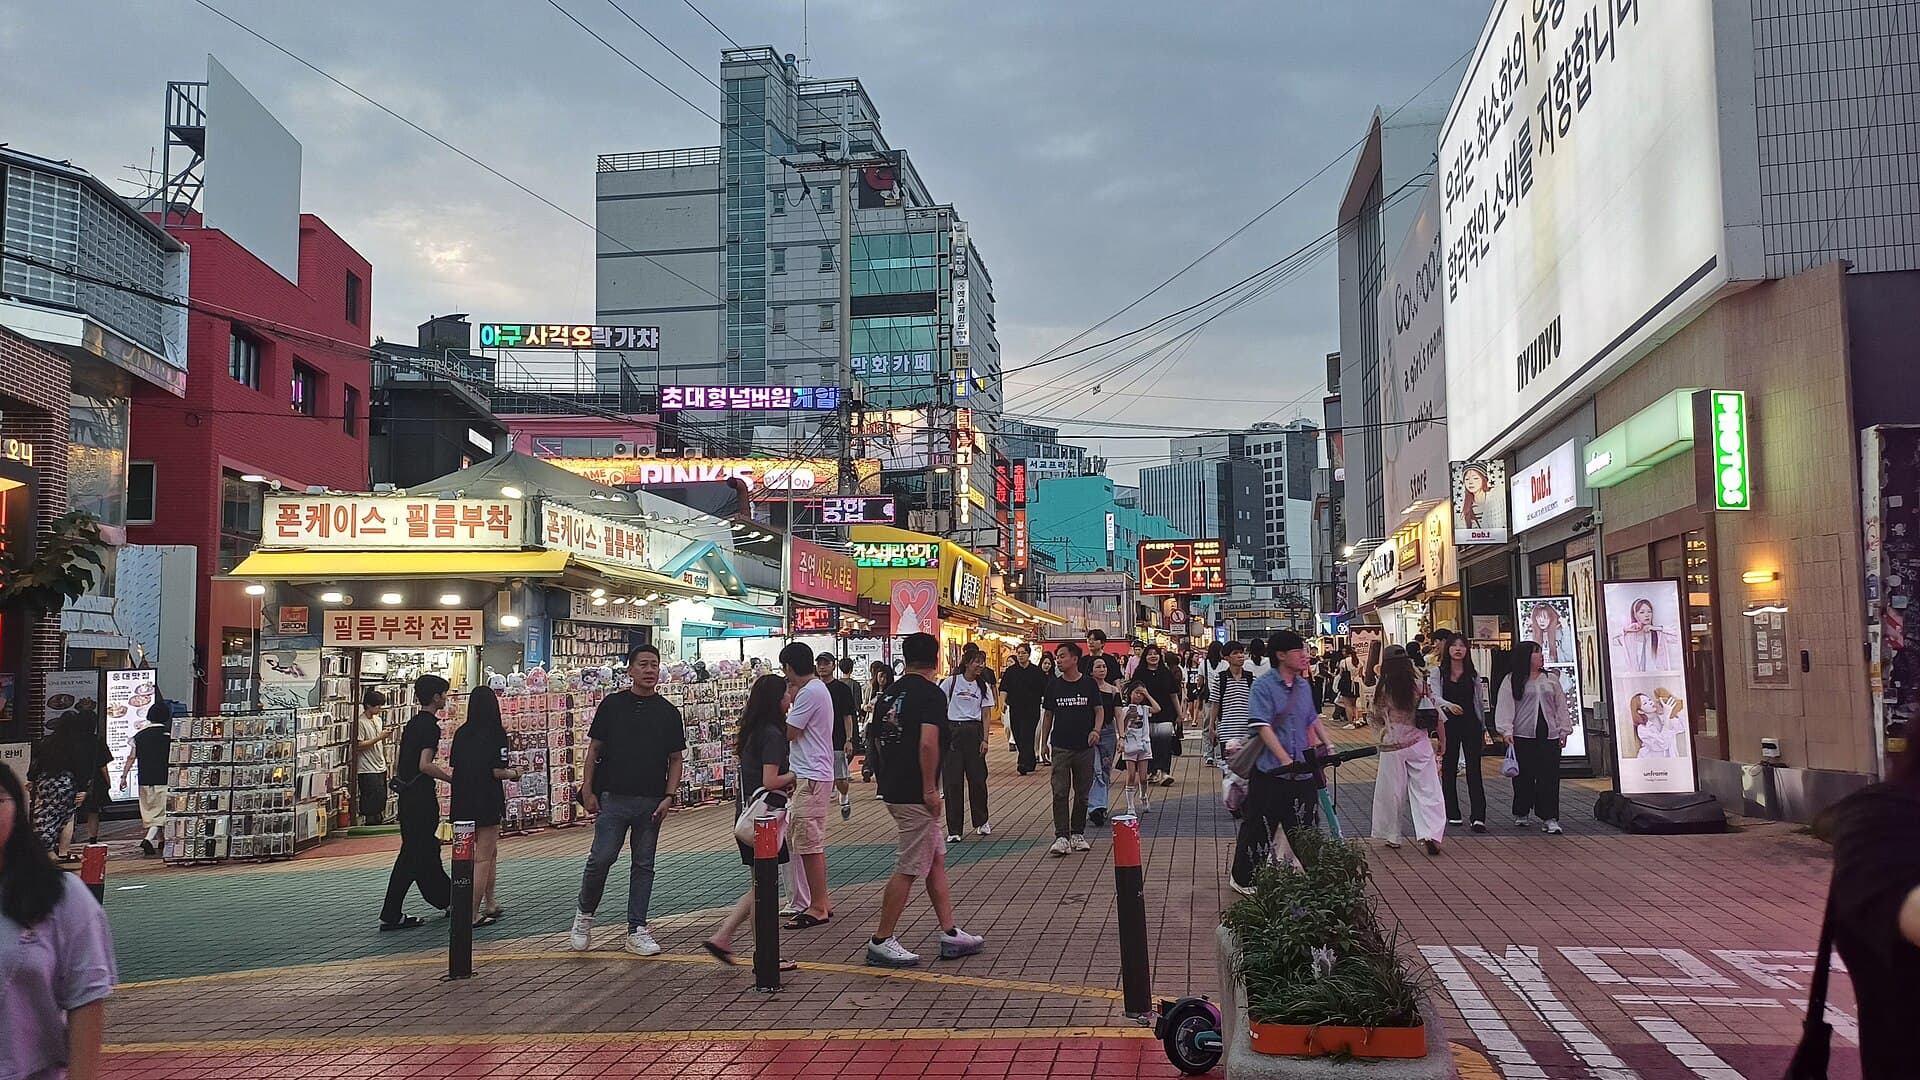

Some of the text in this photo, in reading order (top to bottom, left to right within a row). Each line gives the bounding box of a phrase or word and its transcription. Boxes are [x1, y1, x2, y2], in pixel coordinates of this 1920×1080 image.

[1445, 139, 1475, 224] 우리는
[1477, 14, 1528, 162] 최소한의
[1448, 189, 1490, 304] 합리적인
[1493, 116, 1534, 234] 소비를
[850, 352, 931, 375] 만화카페
[1717, 395, 1744, 505] PHOTOS
[1409, 467, 1428, 500] store
[275, 502, 513, 540] 폰케이스 필름부착
[547, 510, 645, 563] 폰케이스 필름부착
[816, 556, 833, 590] 사주
[839, 565, 852, 593] 타로
[333, 614, 475, 641] 필름부착 전문
[4, 748, 23, 759] 완비
